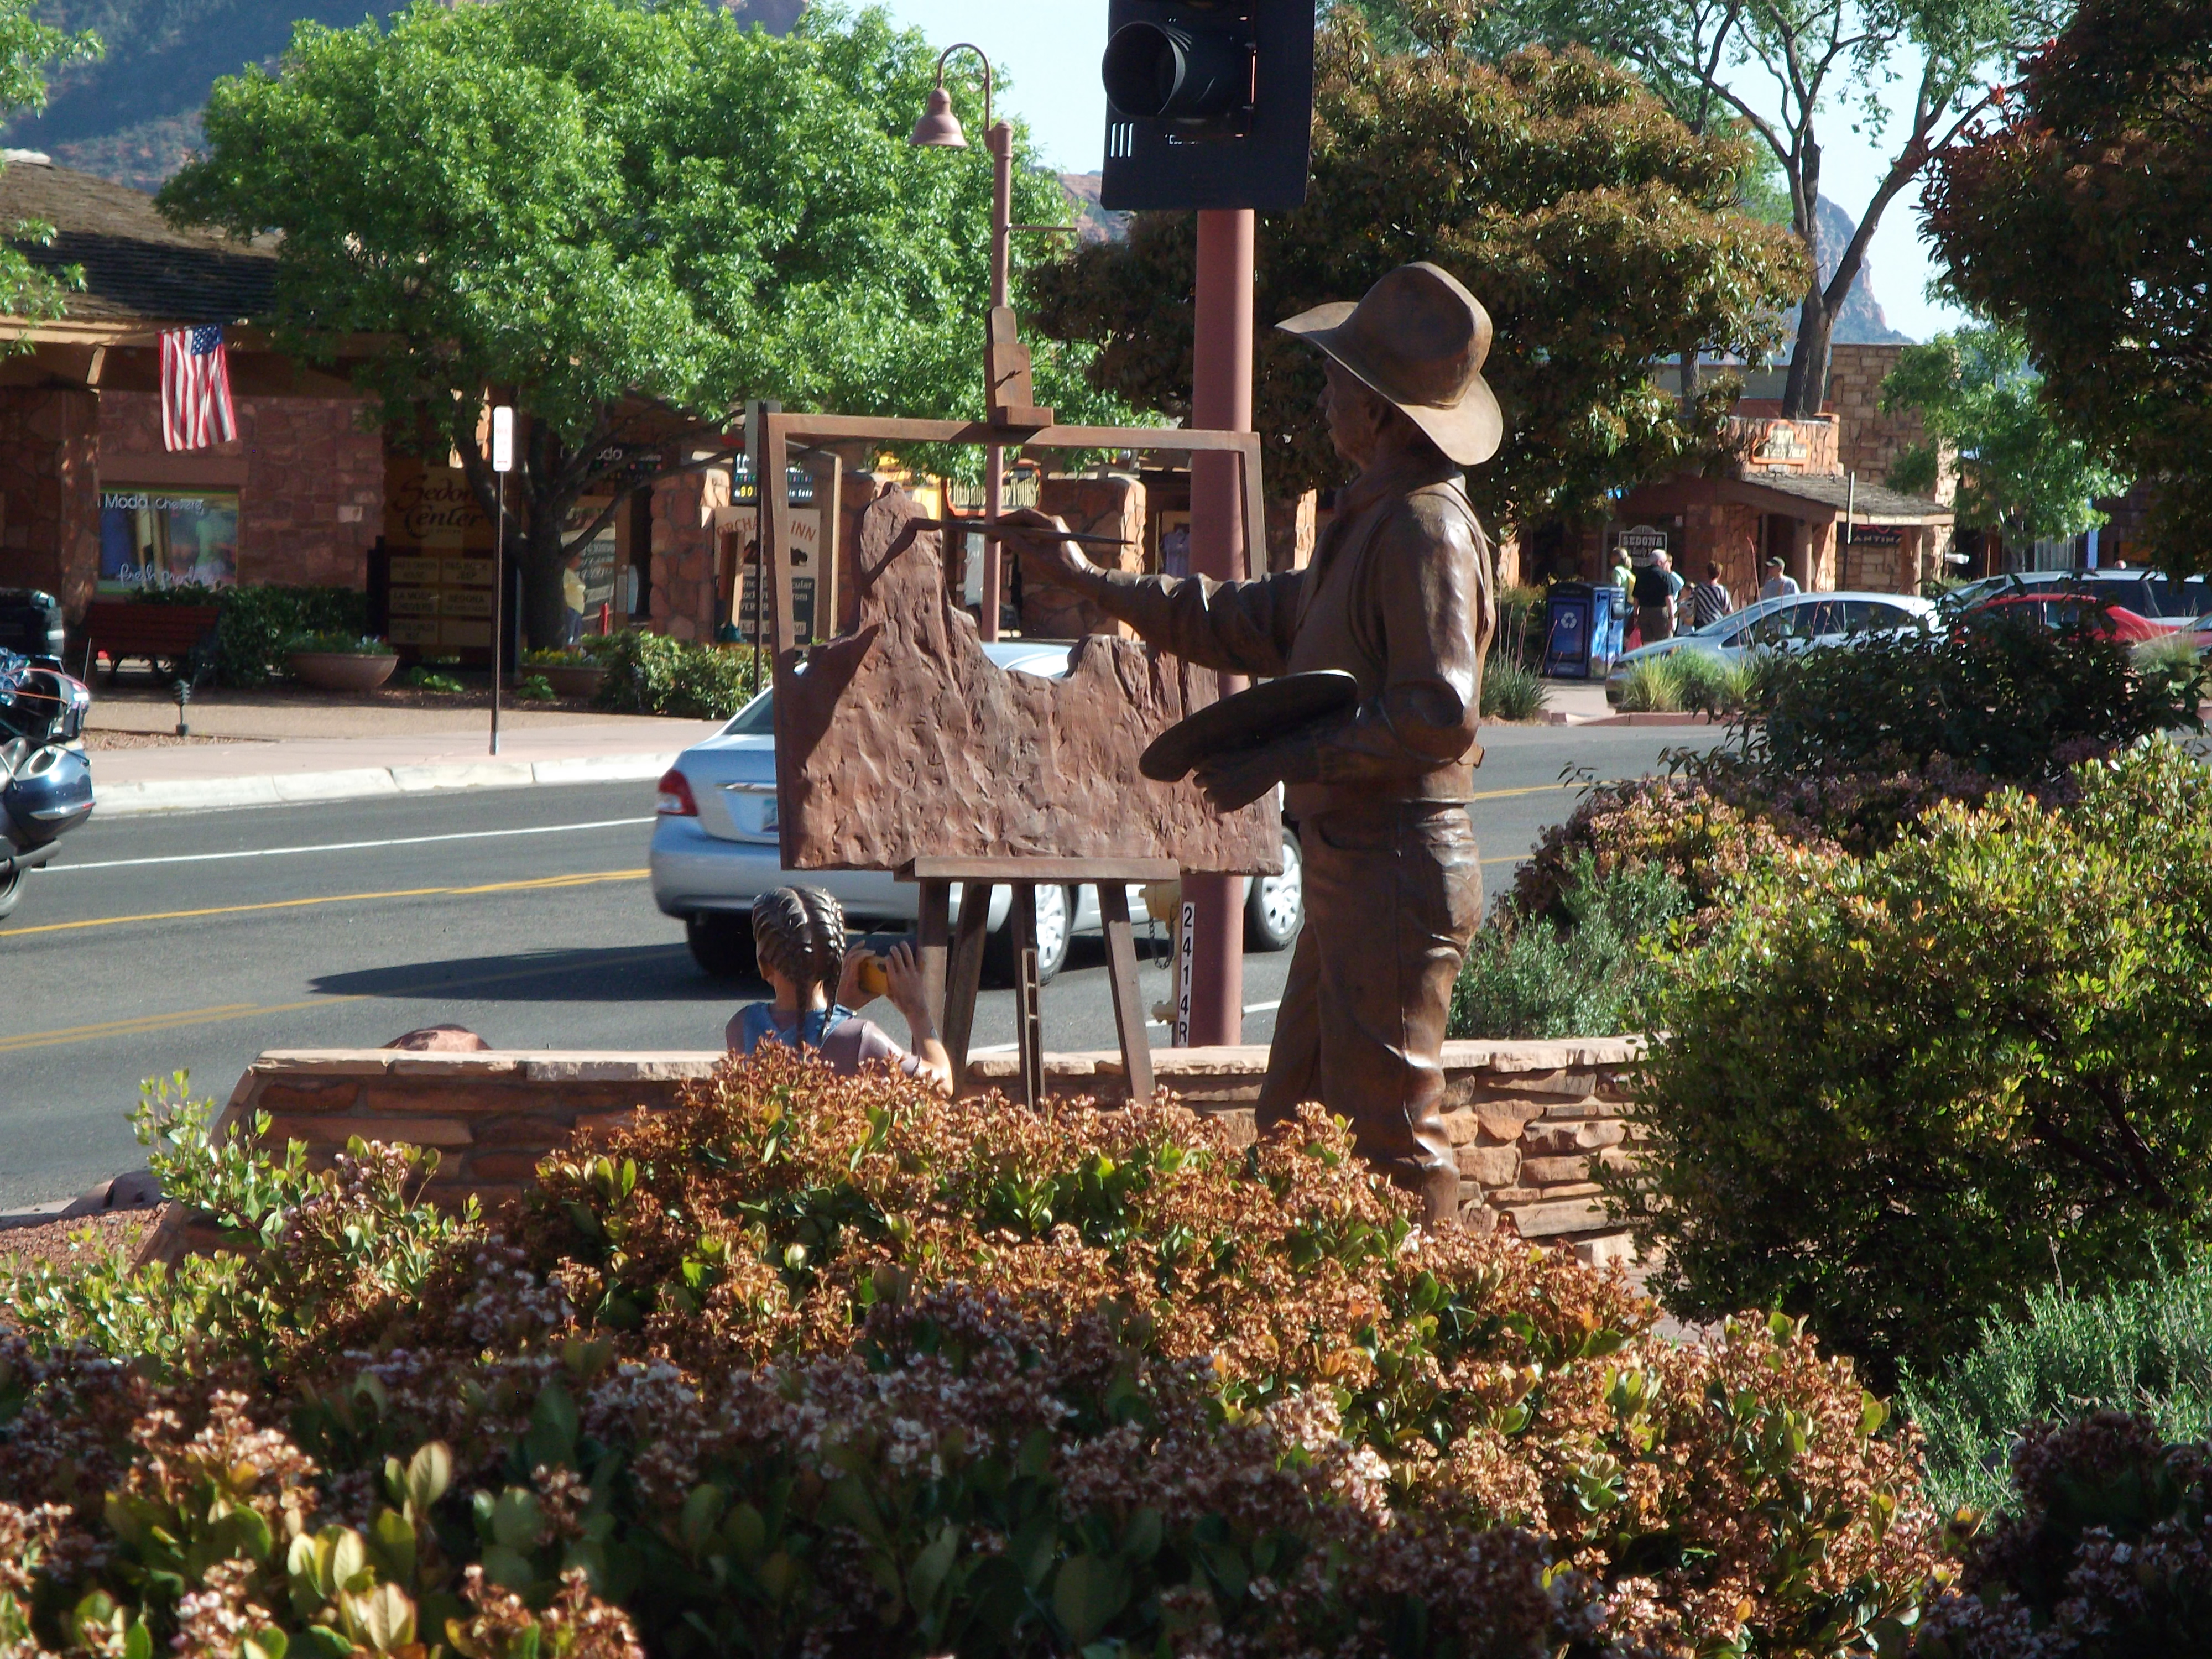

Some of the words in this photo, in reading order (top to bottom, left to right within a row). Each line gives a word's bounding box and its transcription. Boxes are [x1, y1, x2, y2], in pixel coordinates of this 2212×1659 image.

[392, 473, 474, 513] Sedon
[405, 504, 484, 539] Center
[790, 520, 816, 542] INN
[1623, 535, 1663, 547] SEDONA
[1179, 906, 1193, 1043] 2414R
